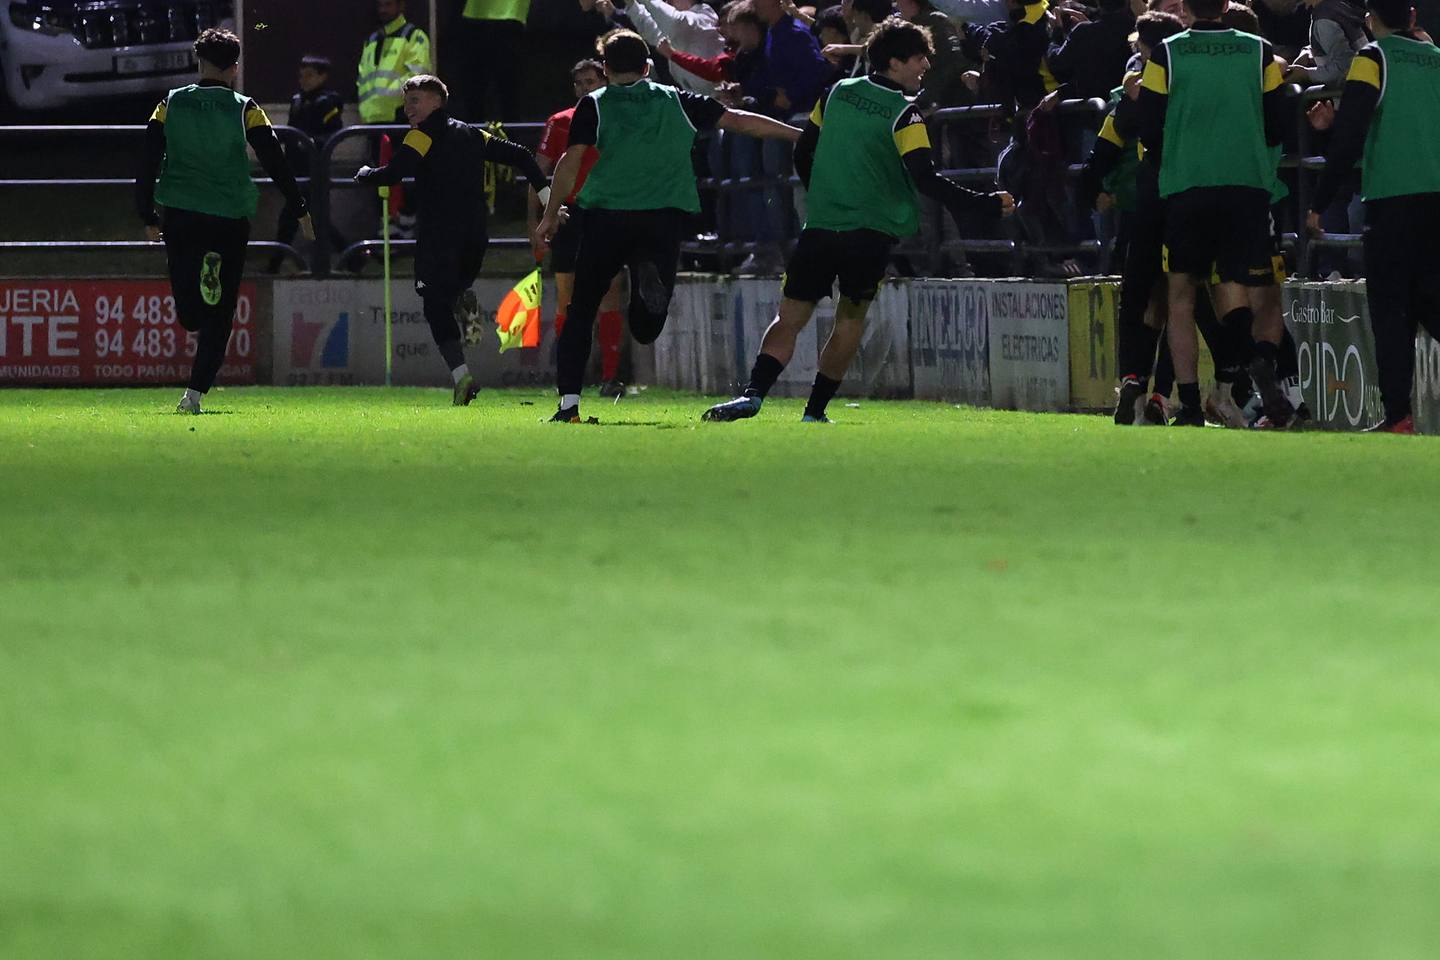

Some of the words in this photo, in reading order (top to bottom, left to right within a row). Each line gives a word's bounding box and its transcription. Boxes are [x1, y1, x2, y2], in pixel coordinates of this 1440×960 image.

[95, 295, 124, 324] 94
[132, 295, 177, 324] 483
[991, 291, 1066, 321] INSTALACIONES
[1291, 299, 1319, 324] Gastro
[1320, 300, 1335, 324] Bar
[95, 328, 124, 357] 94
[132, 328, 177, 357] 483
[396, 343, 428, 359] que
[1001, 334, 1059, 363] ELECTRICAS
[94, 364, 134, 378] TODO
[137, 364, 175, 378] PARA
